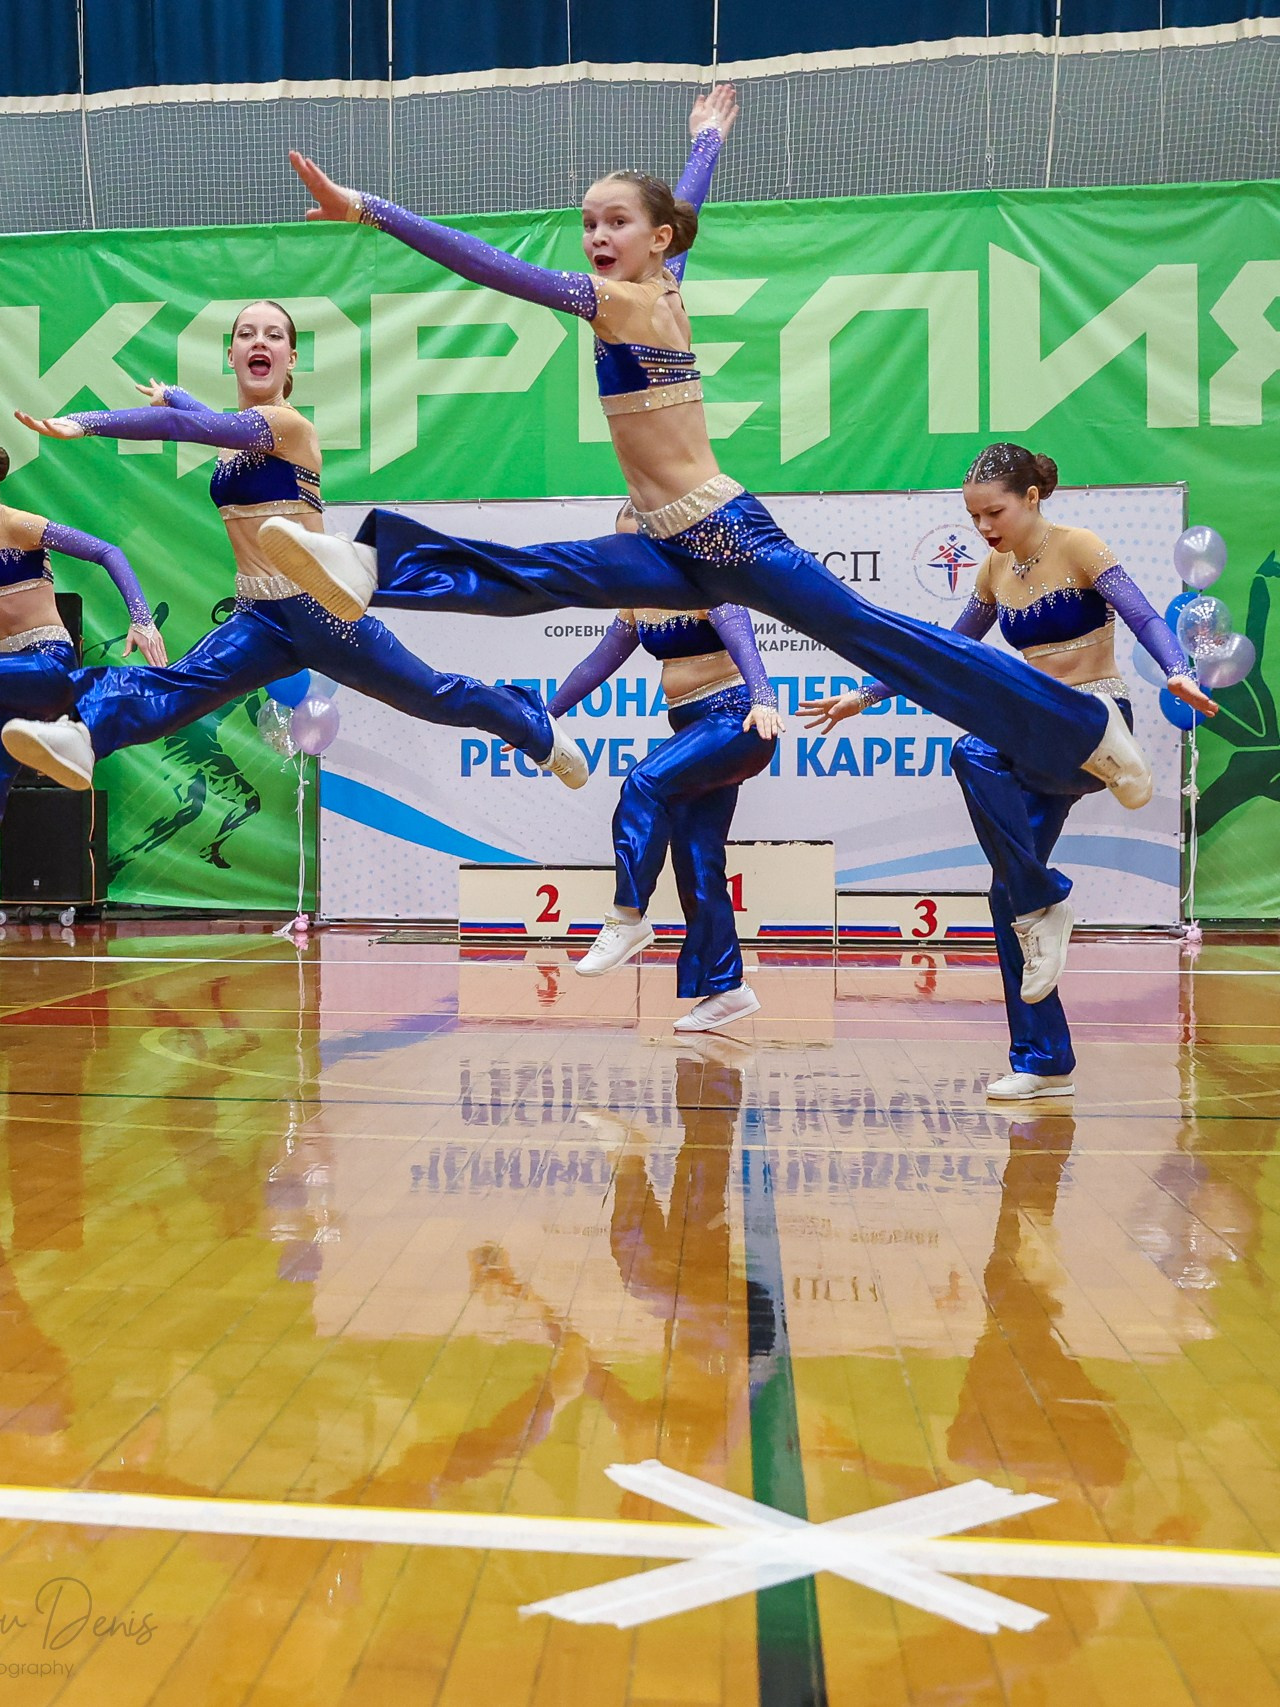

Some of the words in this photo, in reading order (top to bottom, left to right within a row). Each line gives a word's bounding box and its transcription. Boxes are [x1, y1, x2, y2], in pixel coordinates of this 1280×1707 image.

[758, 640, 827, 652] КАРЕЛИ
[797, 737, 953, 777] КАРЕЛ
[535, 884, 561, 923] 2
[726, 872, 748, 912] 1
[911, 898, 939, 938] 3
